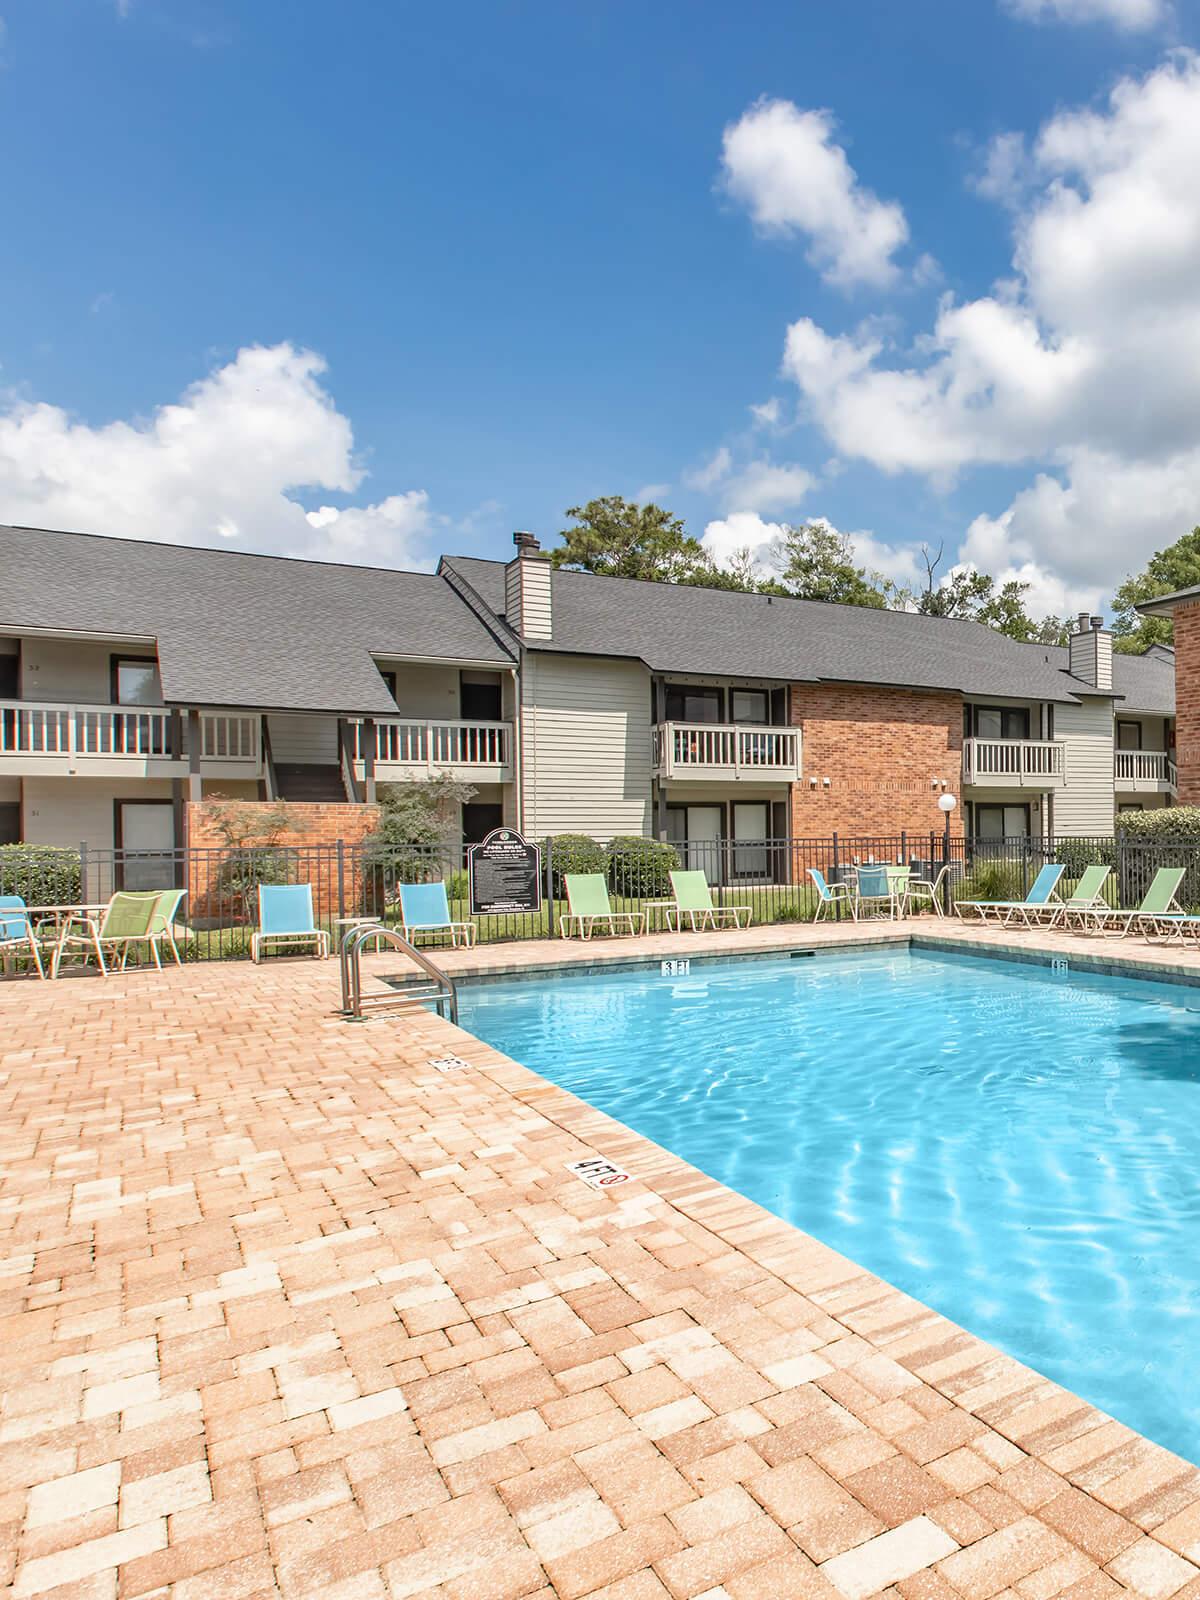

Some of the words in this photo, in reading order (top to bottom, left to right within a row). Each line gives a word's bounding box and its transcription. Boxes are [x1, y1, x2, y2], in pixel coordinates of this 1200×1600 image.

[665, 961, 672, 970] 3
[676, 960, 688, 969] FT
[574, 1160, 603, 1169] 4
[580, 1165, 617, 1178] FT
